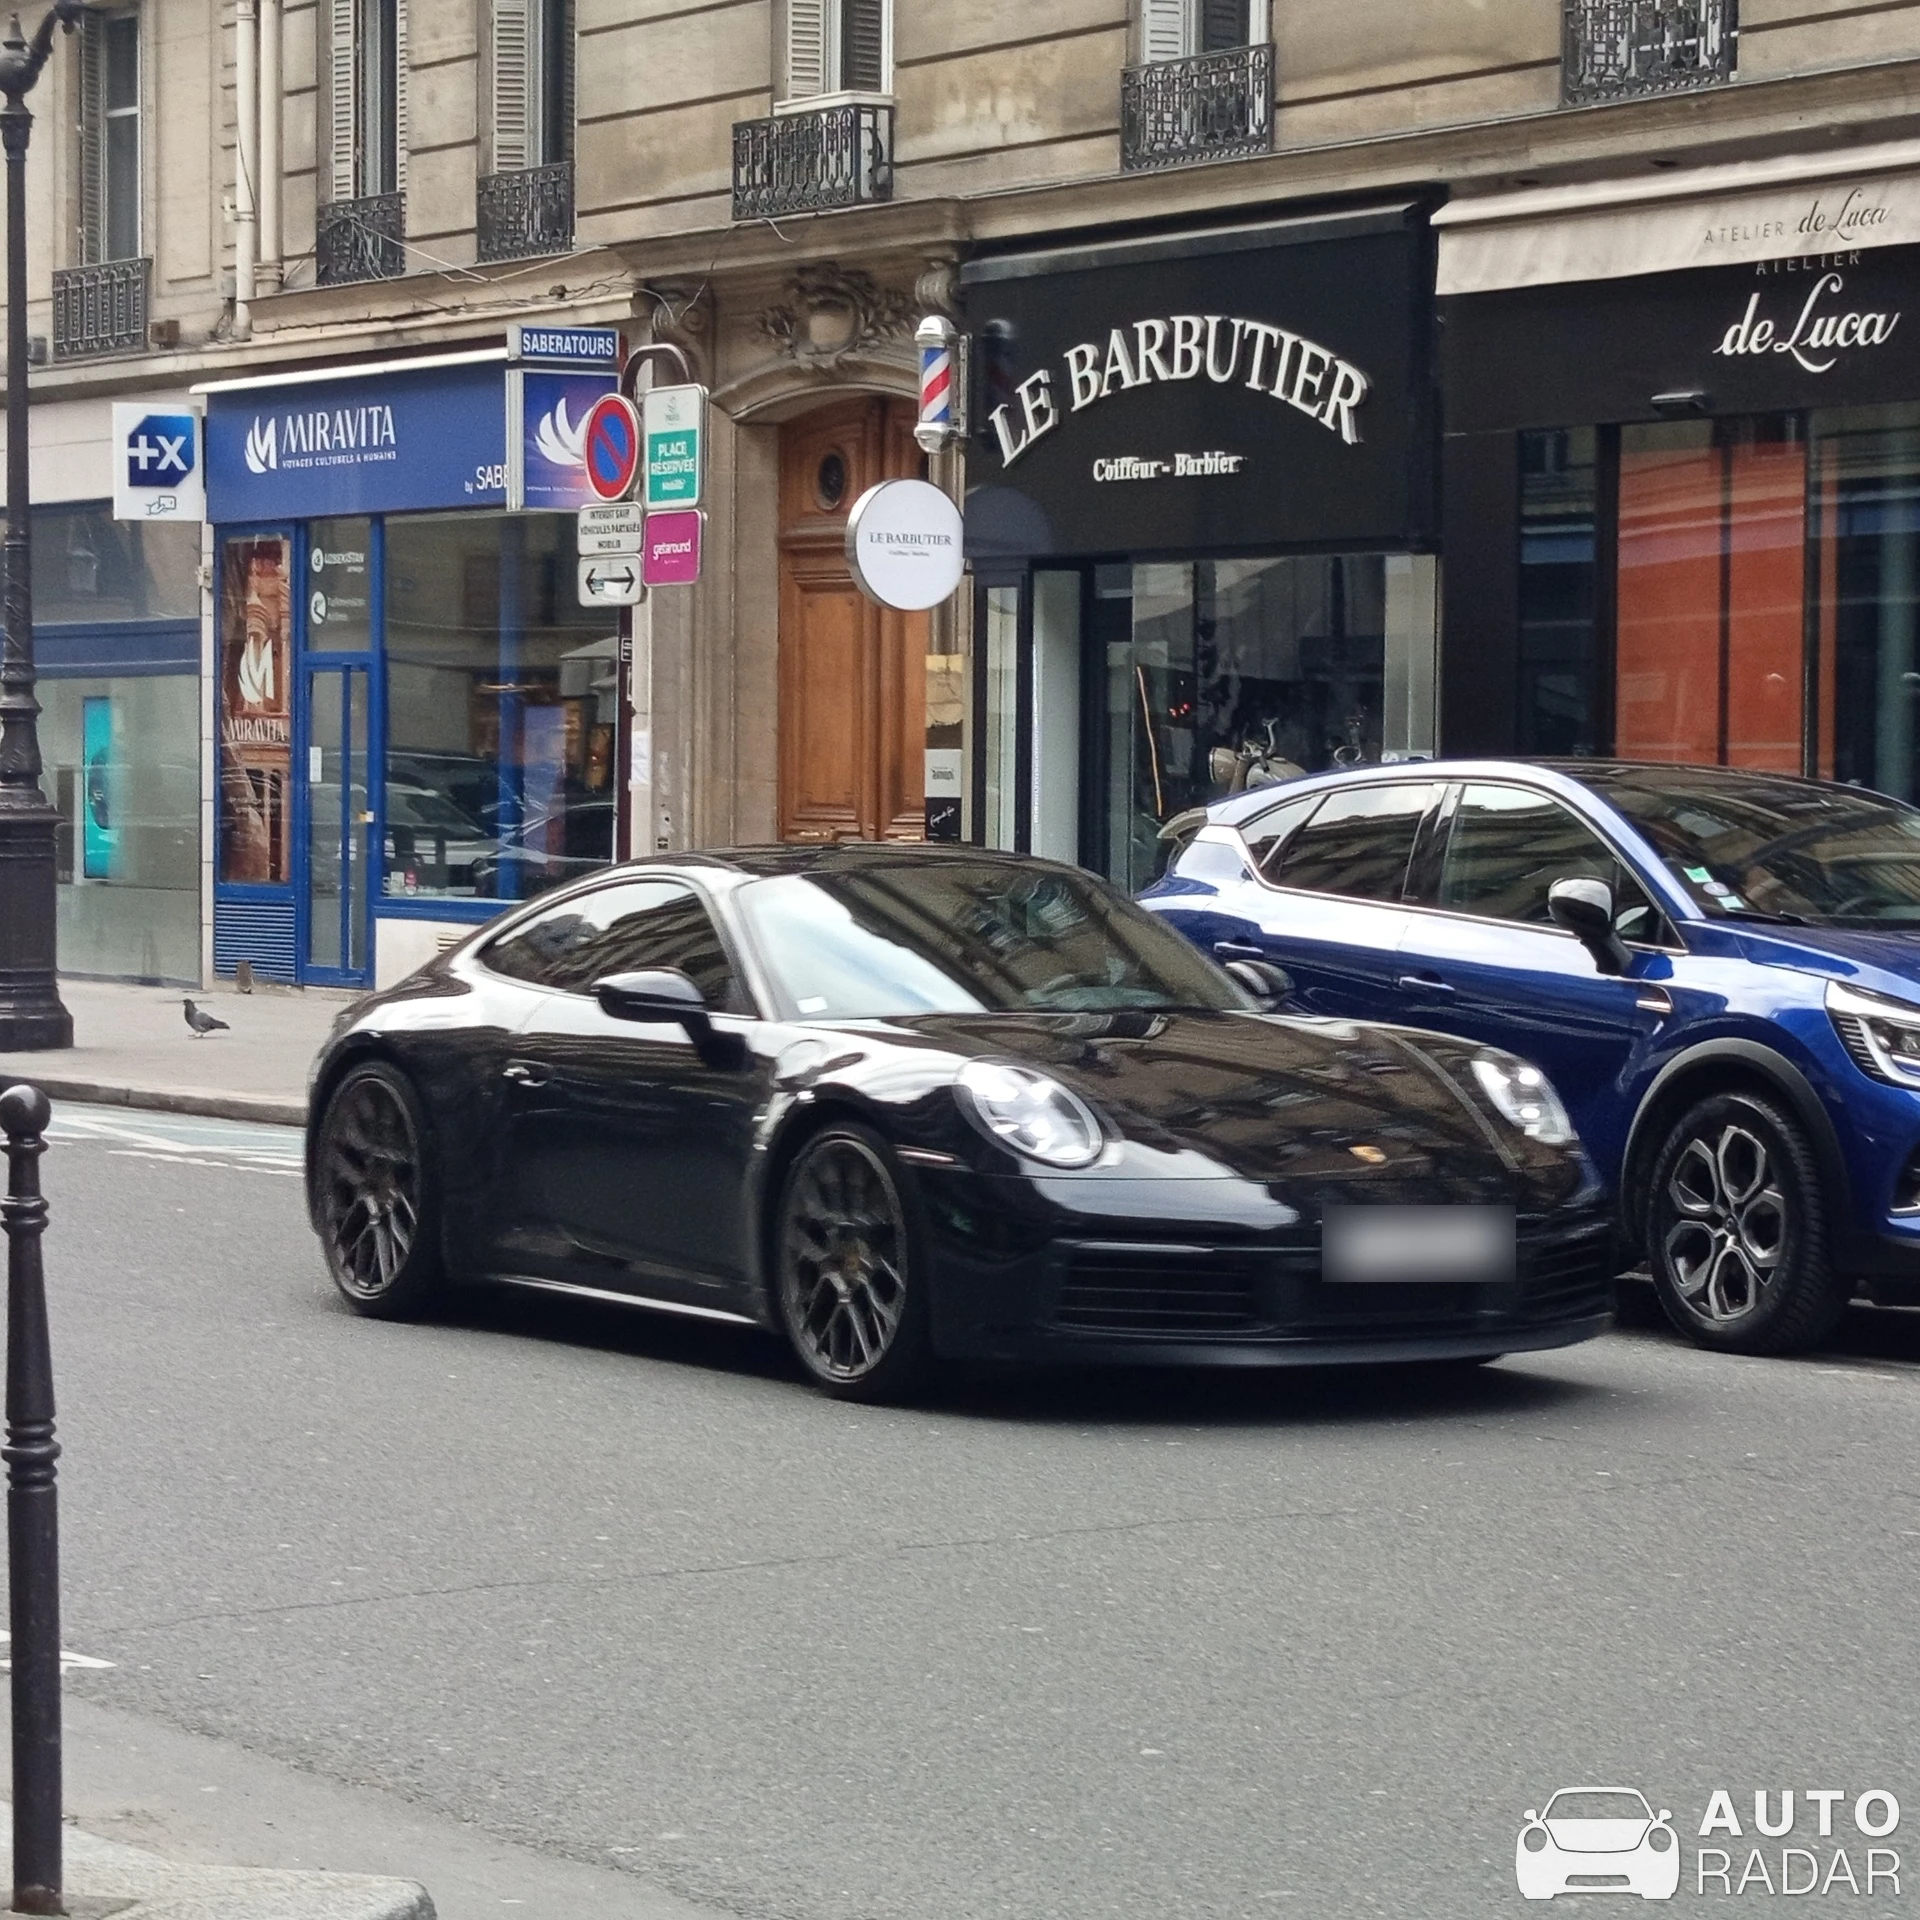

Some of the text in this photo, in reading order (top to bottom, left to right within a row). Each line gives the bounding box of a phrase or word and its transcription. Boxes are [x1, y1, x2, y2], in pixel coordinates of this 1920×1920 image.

[1704, 187, 1890, 244] ATELIER de Luca
[1712, 272, 1901, 374] de Luca
[522, 332, 614, 356] SABERATOURS
[988, 314, 1374, 469] LE BARBUTIER
[282, 405, 397, 455] MIRAVITA
[282, 458, 313, 469] VOYAGES
[658, 441, 687, 458] PLACE
[1093, 456, 1164, 482] Coiffeur
[1174, 451, 1244, 477] Barbier
[870, 532, 953, 545] LE BARBUTIER
